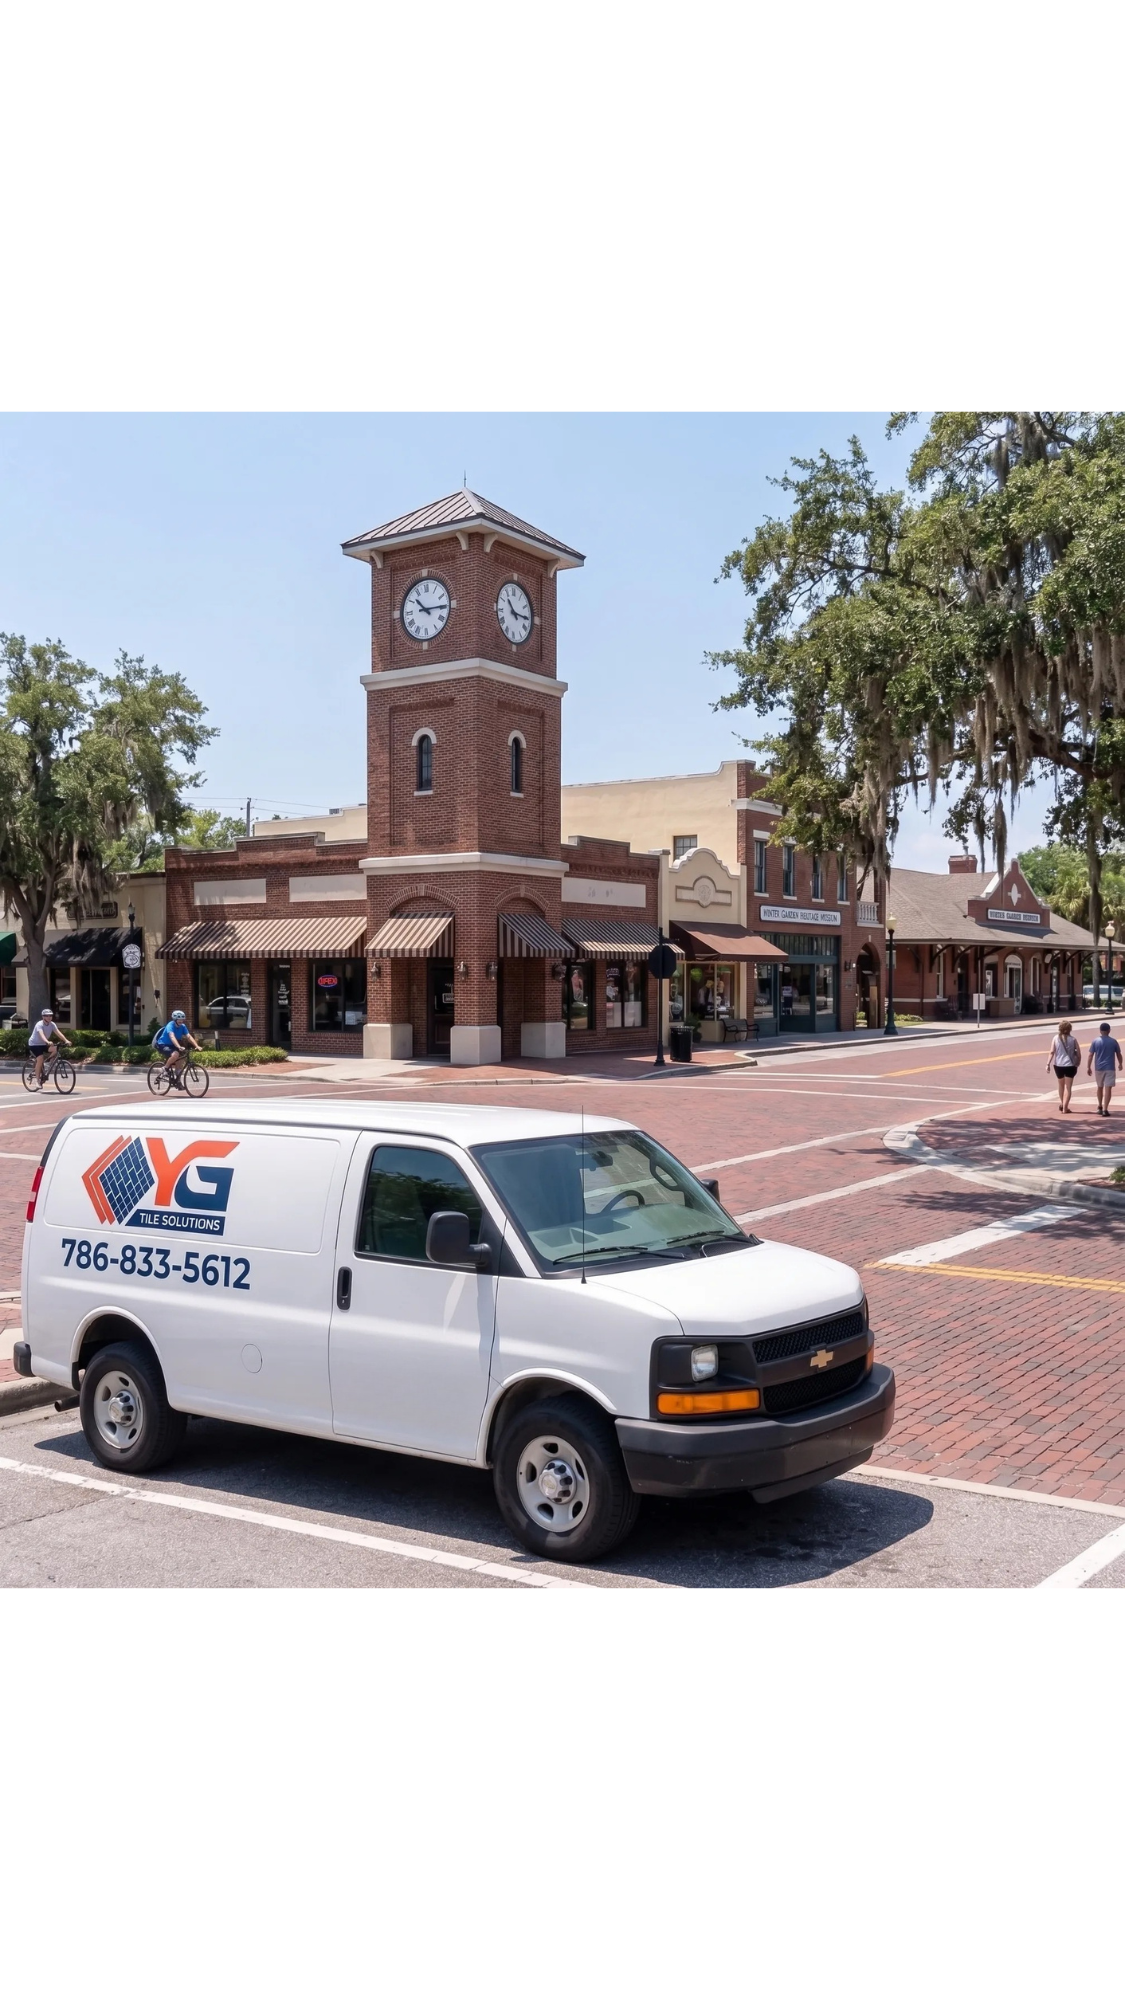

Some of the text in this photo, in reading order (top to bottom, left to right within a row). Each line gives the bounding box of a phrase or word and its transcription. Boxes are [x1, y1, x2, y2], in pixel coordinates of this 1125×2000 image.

[145, 1137, 240, 1212] YG
[139, 1212, 221, 1231] TILE SOLUTIONS
[61, 1238, 251, 1290] 786-833-5612
